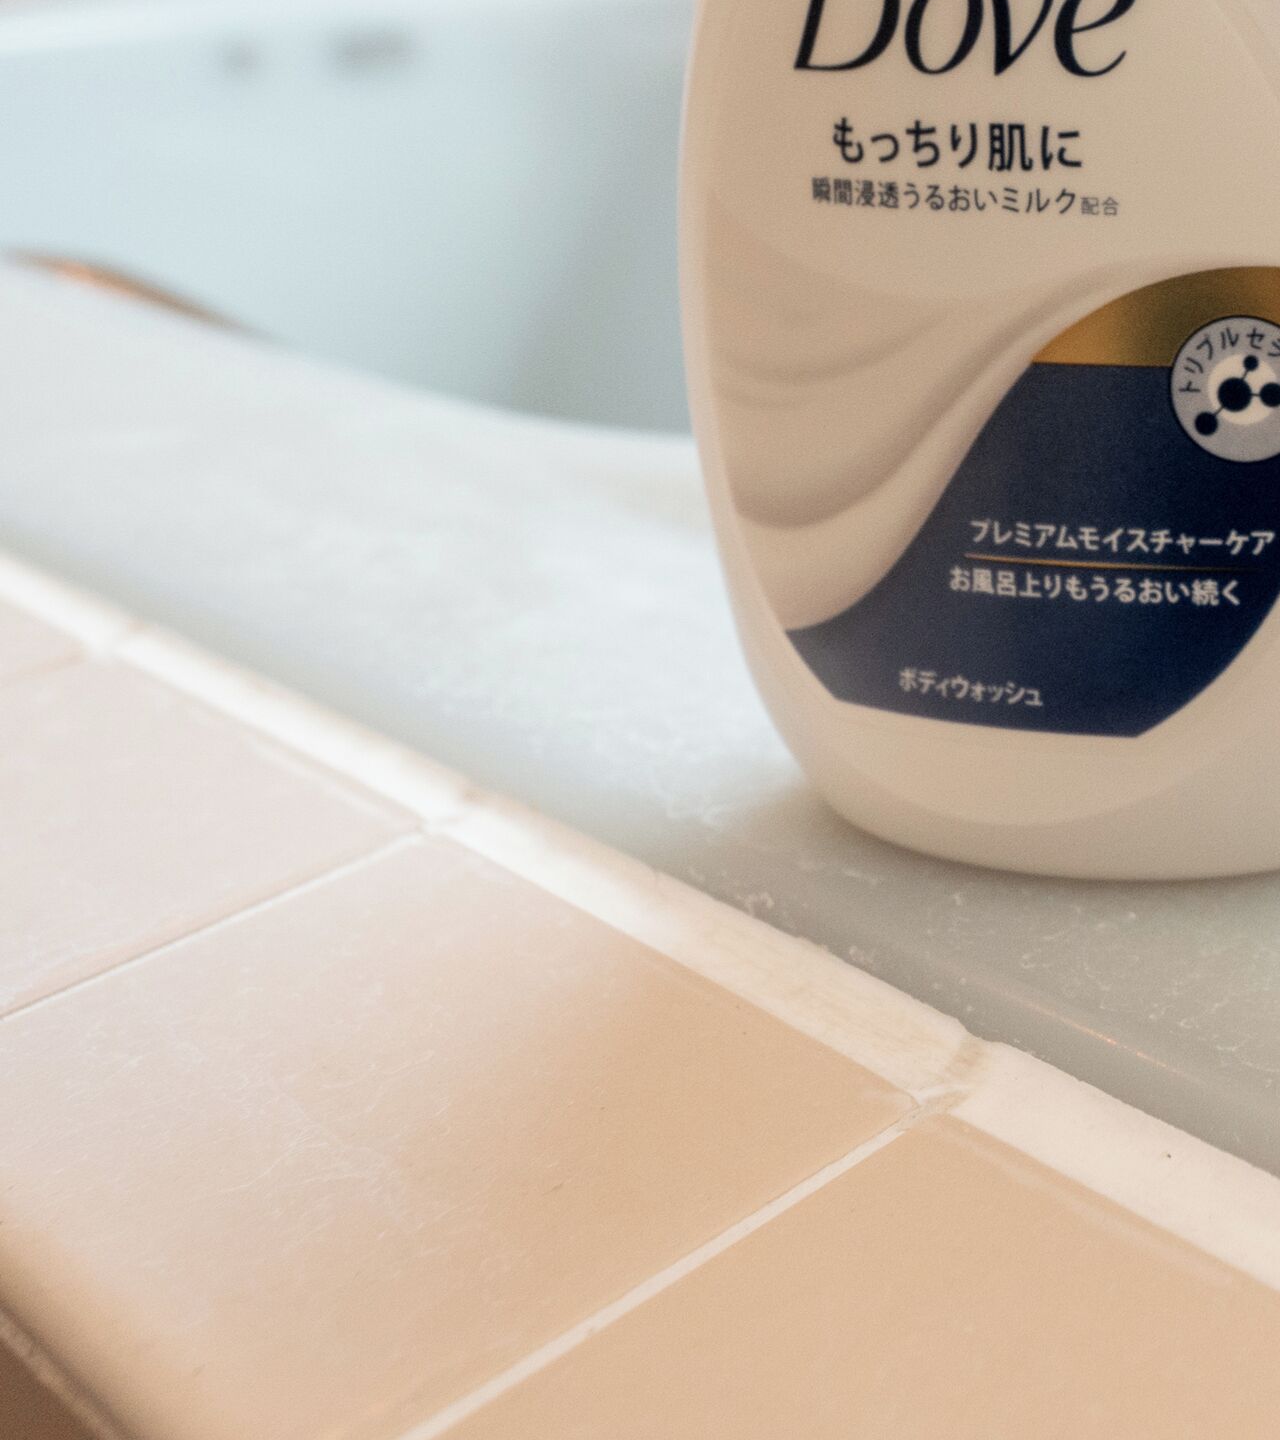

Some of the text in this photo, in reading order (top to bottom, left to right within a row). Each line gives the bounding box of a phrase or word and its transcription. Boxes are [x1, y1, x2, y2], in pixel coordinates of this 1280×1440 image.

[832, 117, 1083, 172] もっちり肌に
[811, 177, 1119, 218] 瞬間浸透うるおいミルク配合
[969, 519, 1275, 556] プレミアムモイスチャーケア
[949, 565, 1241, 606] お風呂上りもうるおい続く
[899, 667, 1043, 707] ボディウォッシュ
